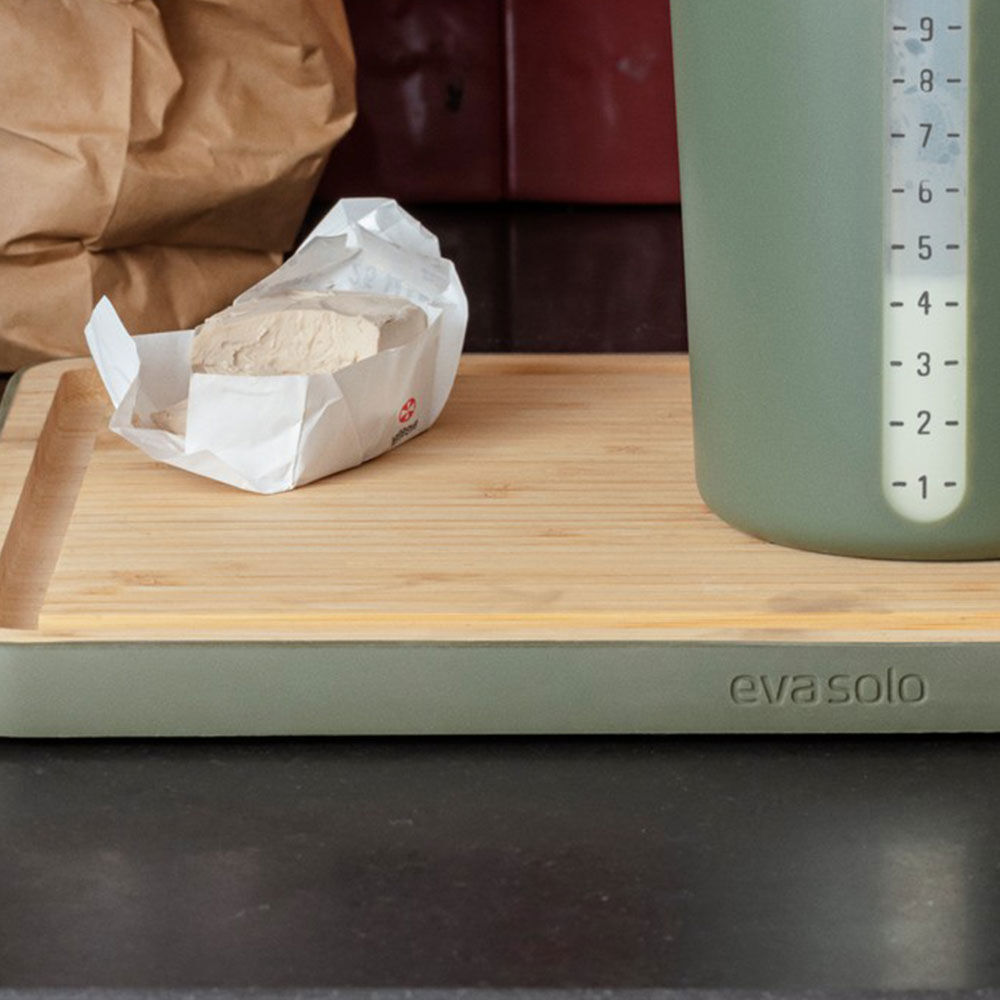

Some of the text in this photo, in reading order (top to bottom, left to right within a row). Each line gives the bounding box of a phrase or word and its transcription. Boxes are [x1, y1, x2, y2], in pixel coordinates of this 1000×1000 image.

[920, 17, 933, 42] 9
[919, 68, 934, 93] 8
[919, 122, 933, 148] 7
[918, 179, 933, 204] 6
[918, 234, 933, 261] 5
[917, 290, 932, 316] 4
[916, 351, 931, 377] 3
[916, 410, 931, 435] 2
[918, 475, 927, 499] 1
